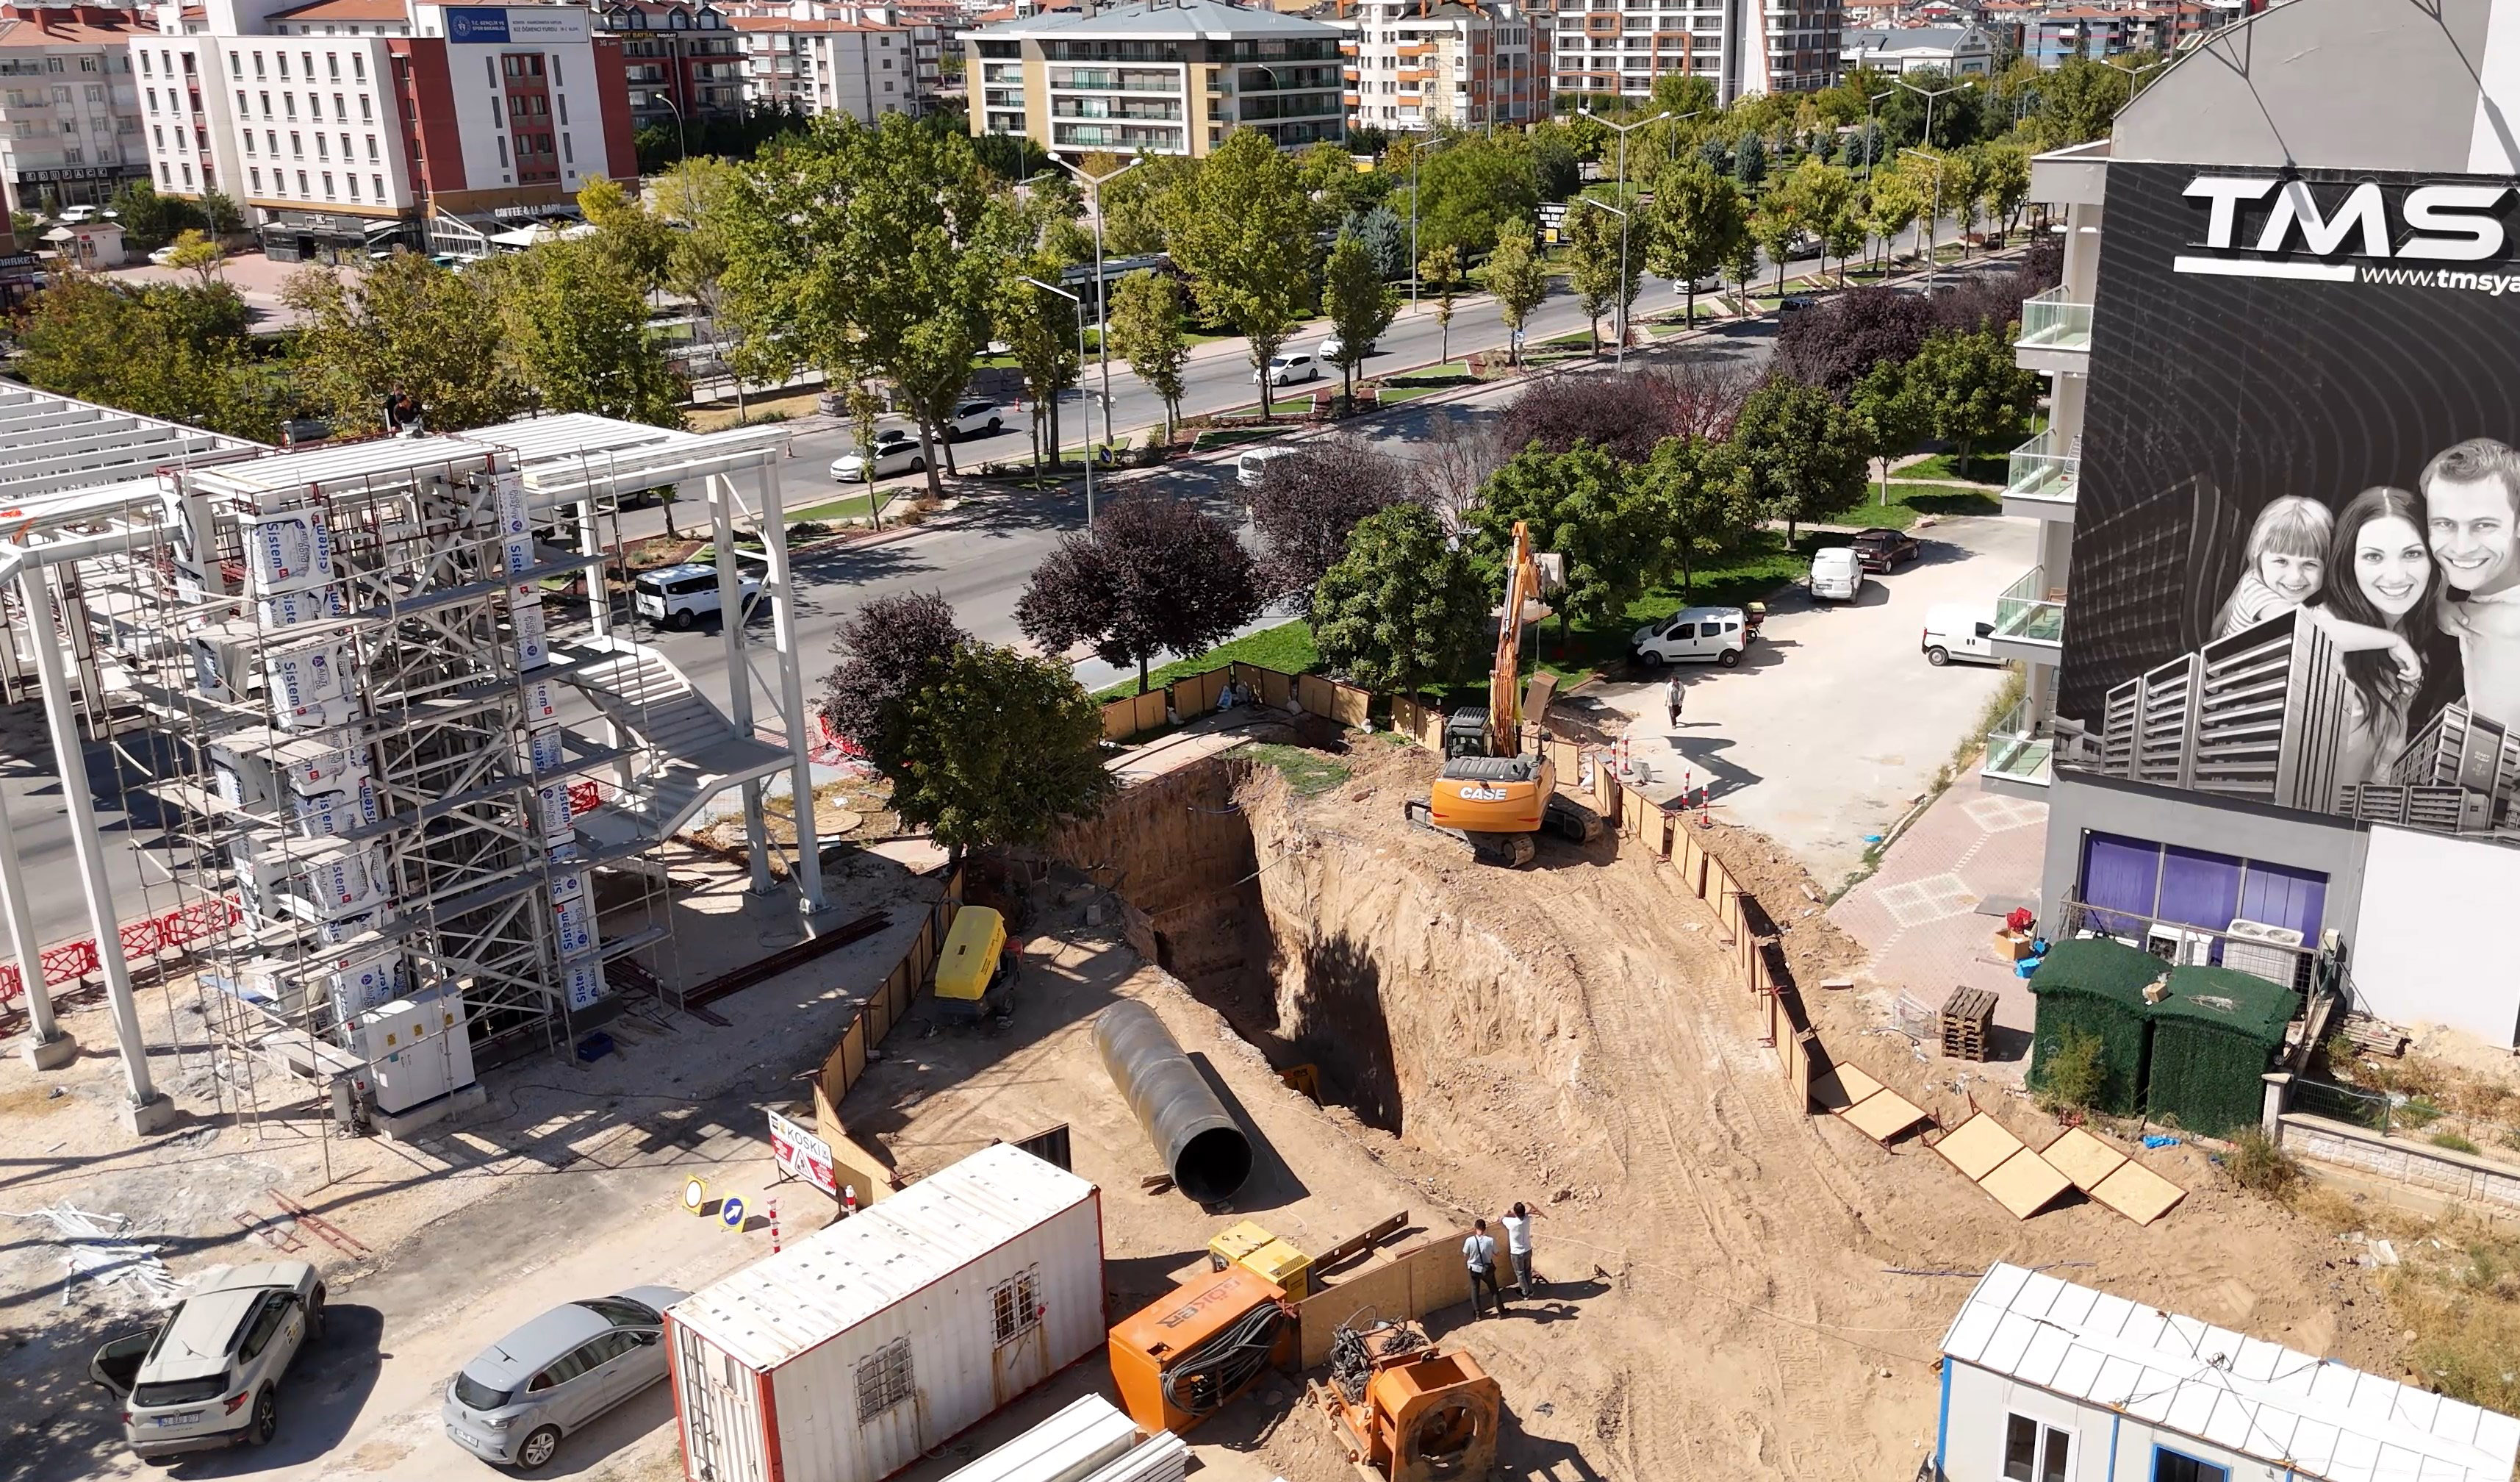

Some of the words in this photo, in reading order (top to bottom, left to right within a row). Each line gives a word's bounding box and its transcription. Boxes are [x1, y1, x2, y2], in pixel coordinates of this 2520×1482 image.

[26, 168, 107, 182] EDUPACK
[495, 207, 523, 218] COFFEE
[523, 206, 529, 215] &
[2181, 177, 2510, 261] TMS
[267, 522, 283, 569] Sistem
[511, 545, 523, 573] Sist
[284, 662, 301, 706] Sistem
[558, 784, 571, 823] Sistem
[1460, 787, 1507, 801] CASE
[561, 912, 573, 950] Sistem
